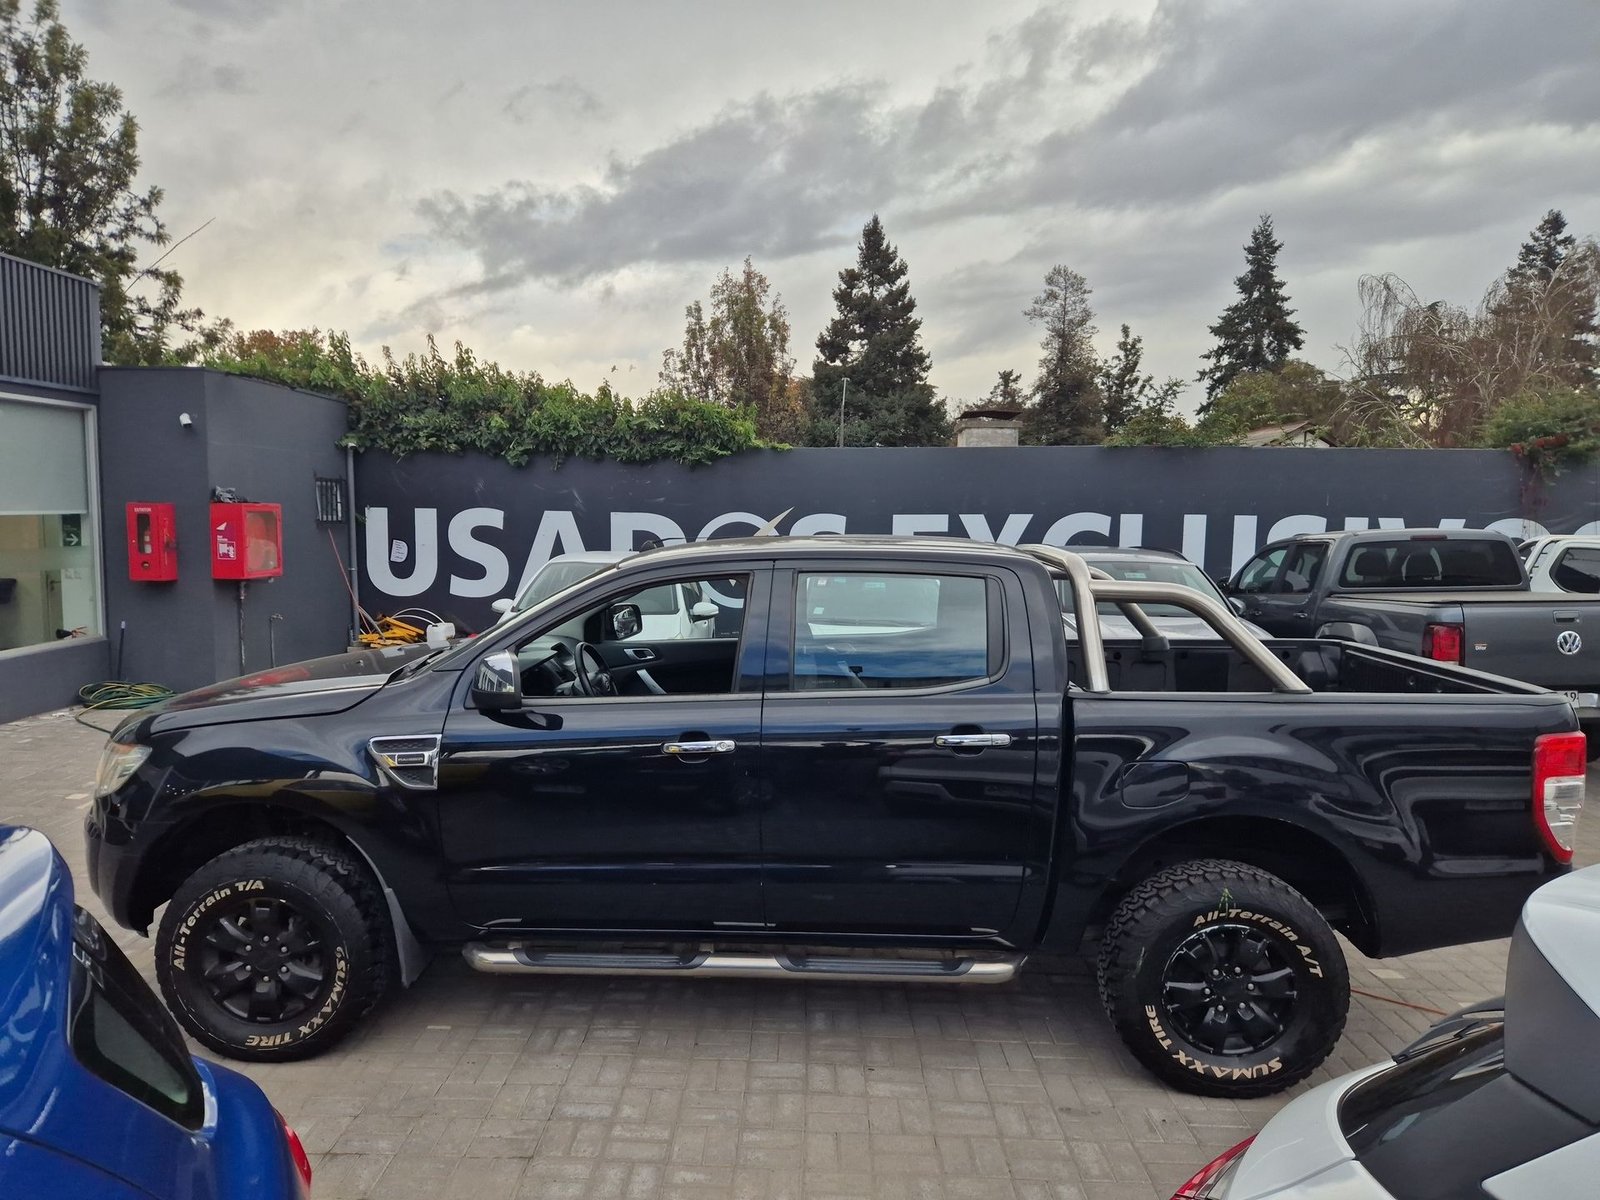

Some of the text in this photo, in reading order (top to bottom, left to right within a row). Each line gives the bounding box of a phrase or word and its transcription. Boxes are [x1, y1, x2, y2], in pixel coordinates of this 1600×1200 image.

[173, 879, 265, 971] All-Terrain T/A
[1193, 908, 1323, 978] All-Terrain A/T
[245, 1032, 293, 1047] TIRE
[1145, 1004, 1283, 1080] SUMAXX TIRE
